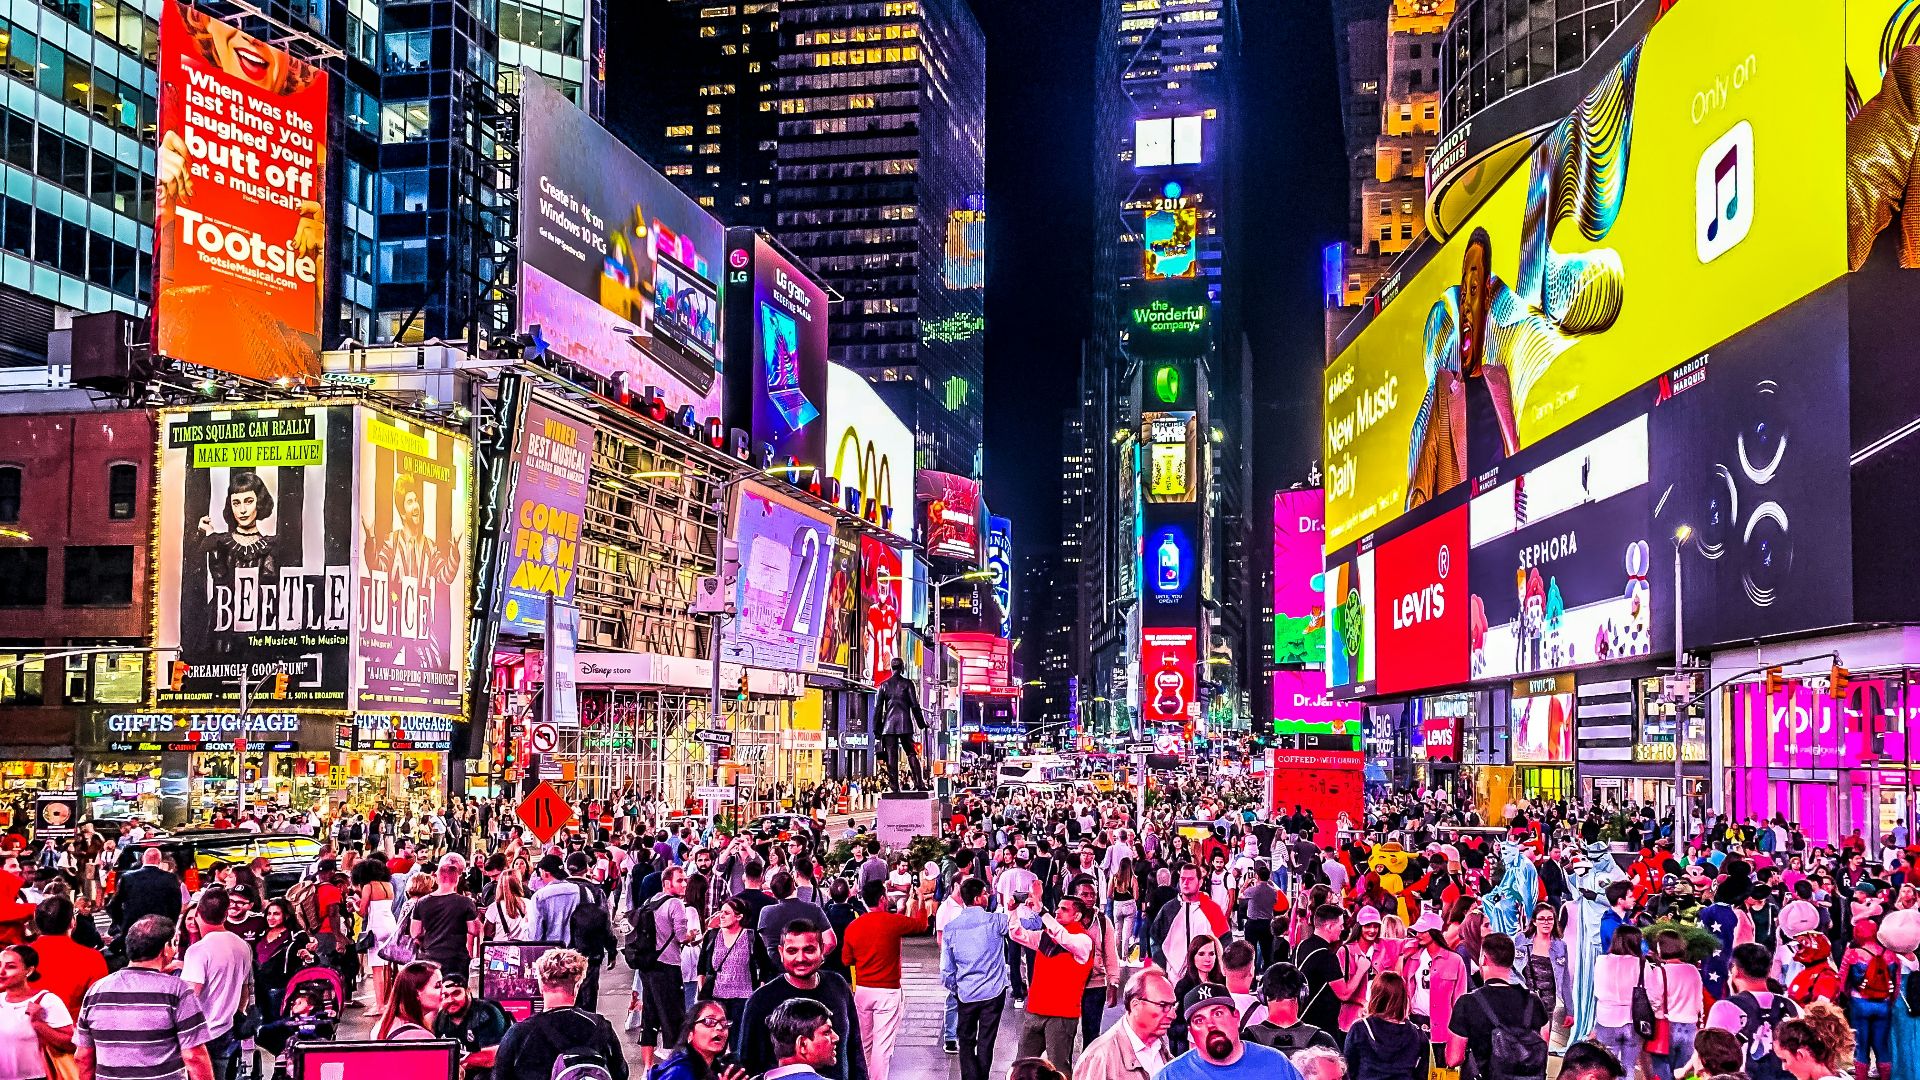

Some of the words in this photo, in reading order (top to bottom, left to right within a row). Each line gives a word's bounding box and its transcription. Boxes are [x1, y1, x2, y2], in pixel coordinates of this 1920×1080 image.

[1690, 76, 1728, 125] Only
[1733, 53, 1757, 90] on
[186, 84, 223, 115] last
[230, 103, 274, 135] time
[279, 126, 313, 152] you
[248, 96, 281, 121] was
[285, 109, 313, 134] the
[185, 104, 267, 152] laughed
[270, 142, 313, 169] your
[1432, 123, 1472, 169] MARRIOTT
[185, 125, 260, 180] butt
[265, 164, 313, 199] off
[191, 162, 209, 180] at
[214, 171, 225, 185] a
[1432, 145, 1465, 185] MARQUIS
[540, 176, 569, 208] Create
[570, 195, 578, 214] in
[592, 215, 604, 231] on
[1155, 199, 1186, 210] 2019
[540, 197, 580, 238] Windows
[582, 226, 591, 244] 10
[592, 233, 607, 255] PCs
[175, 205, 316, 283] Tootsie
[197, 250, 298, 290] TootsieMusical.com
[730, 271, 747, 283] LG
[776, 267, 787, 290] LG
[787, 281, 811, 308] gram
[1134, 305, 1203, 323] Wonderful
[1151, 300, 1168, 311] the
[1151, 321, 1196, 333] company
[328, 374, 372, 385] LAMAR
[1673, 353, 1709, 381] MARRIOTT
[1334, 363, 1354, 401] Music
[1673, 369, 1705, 393] MARQUIS
[1328, 411, 1355, 459] New
[1357, 370, 1398, 437] Music
[172, 426, 203, 443] TIMES
[206, 422, 245, 441] SQUARE
[248, 421, 268, 437] CAN
[271, 418, 312, 436] REALLY
[544, 417, 578, 448] WINNER!
[198, 447, 228, 463] MAKE
[231, 446, 253, 461] YOU
[256, 445, 282, 461] FEEL
[285, 443, 319, 460] ALIVE!
[403, 455, 412, 472] ON
[526, 455, 535, 468] ALL
[528, 433, 551, 459] BEST
[551, 441, 585, 473] MUSICAL
[1328, 452, 1357, 503] Daily
[519, 500, 580, 542] COME
[1519, 531, 1578, 569] SEPHORA
[509, 559, 572, 598] AWAY
[214, 568, 349, 632] BEETLE
[248, 636, 263, 646] The
[300, 635, 316, 646] The
[252, 662, 281, 674] GOOD
[374, 667, 421, 683] JAW-DROPPING
[578, 661, 613, 679] Disney
[613, 667, 632, 675] store
[314, 691, 345, 700] BROADWAY
[1529, 677, 1556, 693] INVICTA
[108, 713, 173, 731] GIFTS
[191, 713, 298, 731] LUGGAGE
[354, 715, 391, 730] GIFTS
[400, 715, 453, 731] LUGGAGE
[1772, 706, 1831, 734] YOU
[200, 731, 220, 741] NY
[414, 741, 434, 749] SONY
[1278, 756, 1316, 764] COFFEED
[1198, 985, 1213, 1000] NY
